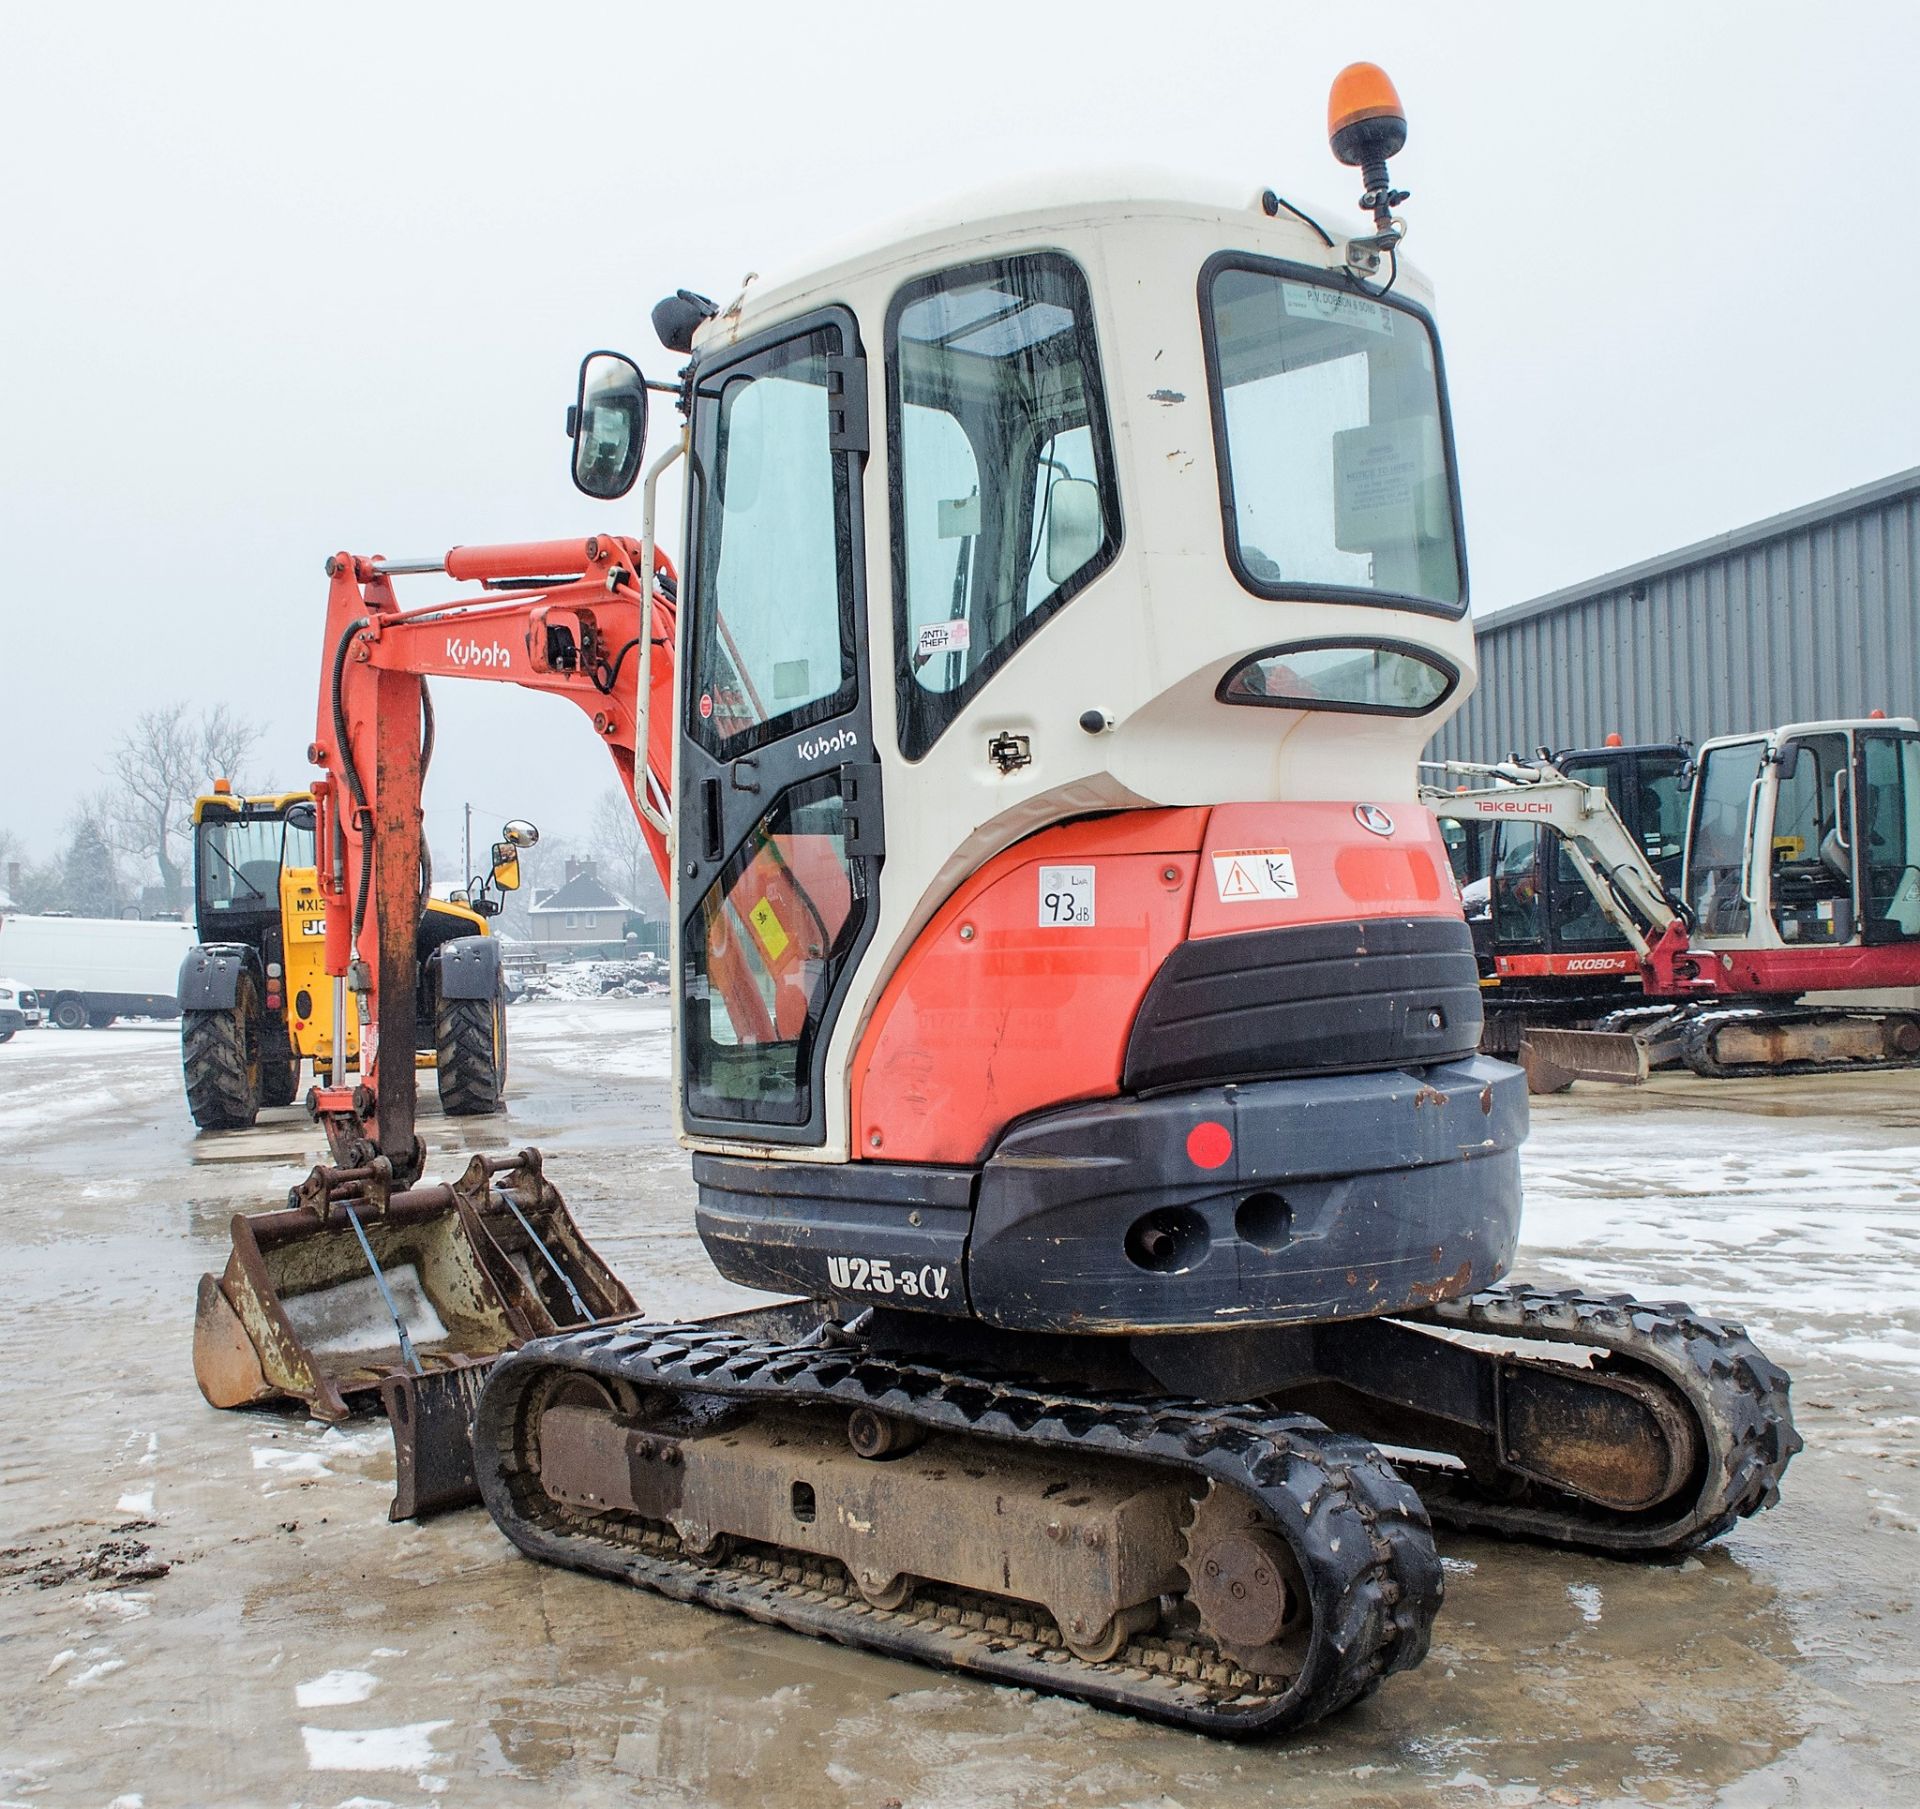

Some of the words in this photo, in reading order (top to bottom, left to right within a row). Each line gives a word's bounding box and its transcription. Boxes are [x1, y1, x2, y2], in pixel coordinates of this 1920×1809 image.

[446, 638, 511, 668] Kubota
[920, 637, 948, 648] THEFT
[797, 729, 858, 761] Kubota
[1566, 958, 1626, 971] KX080-4
